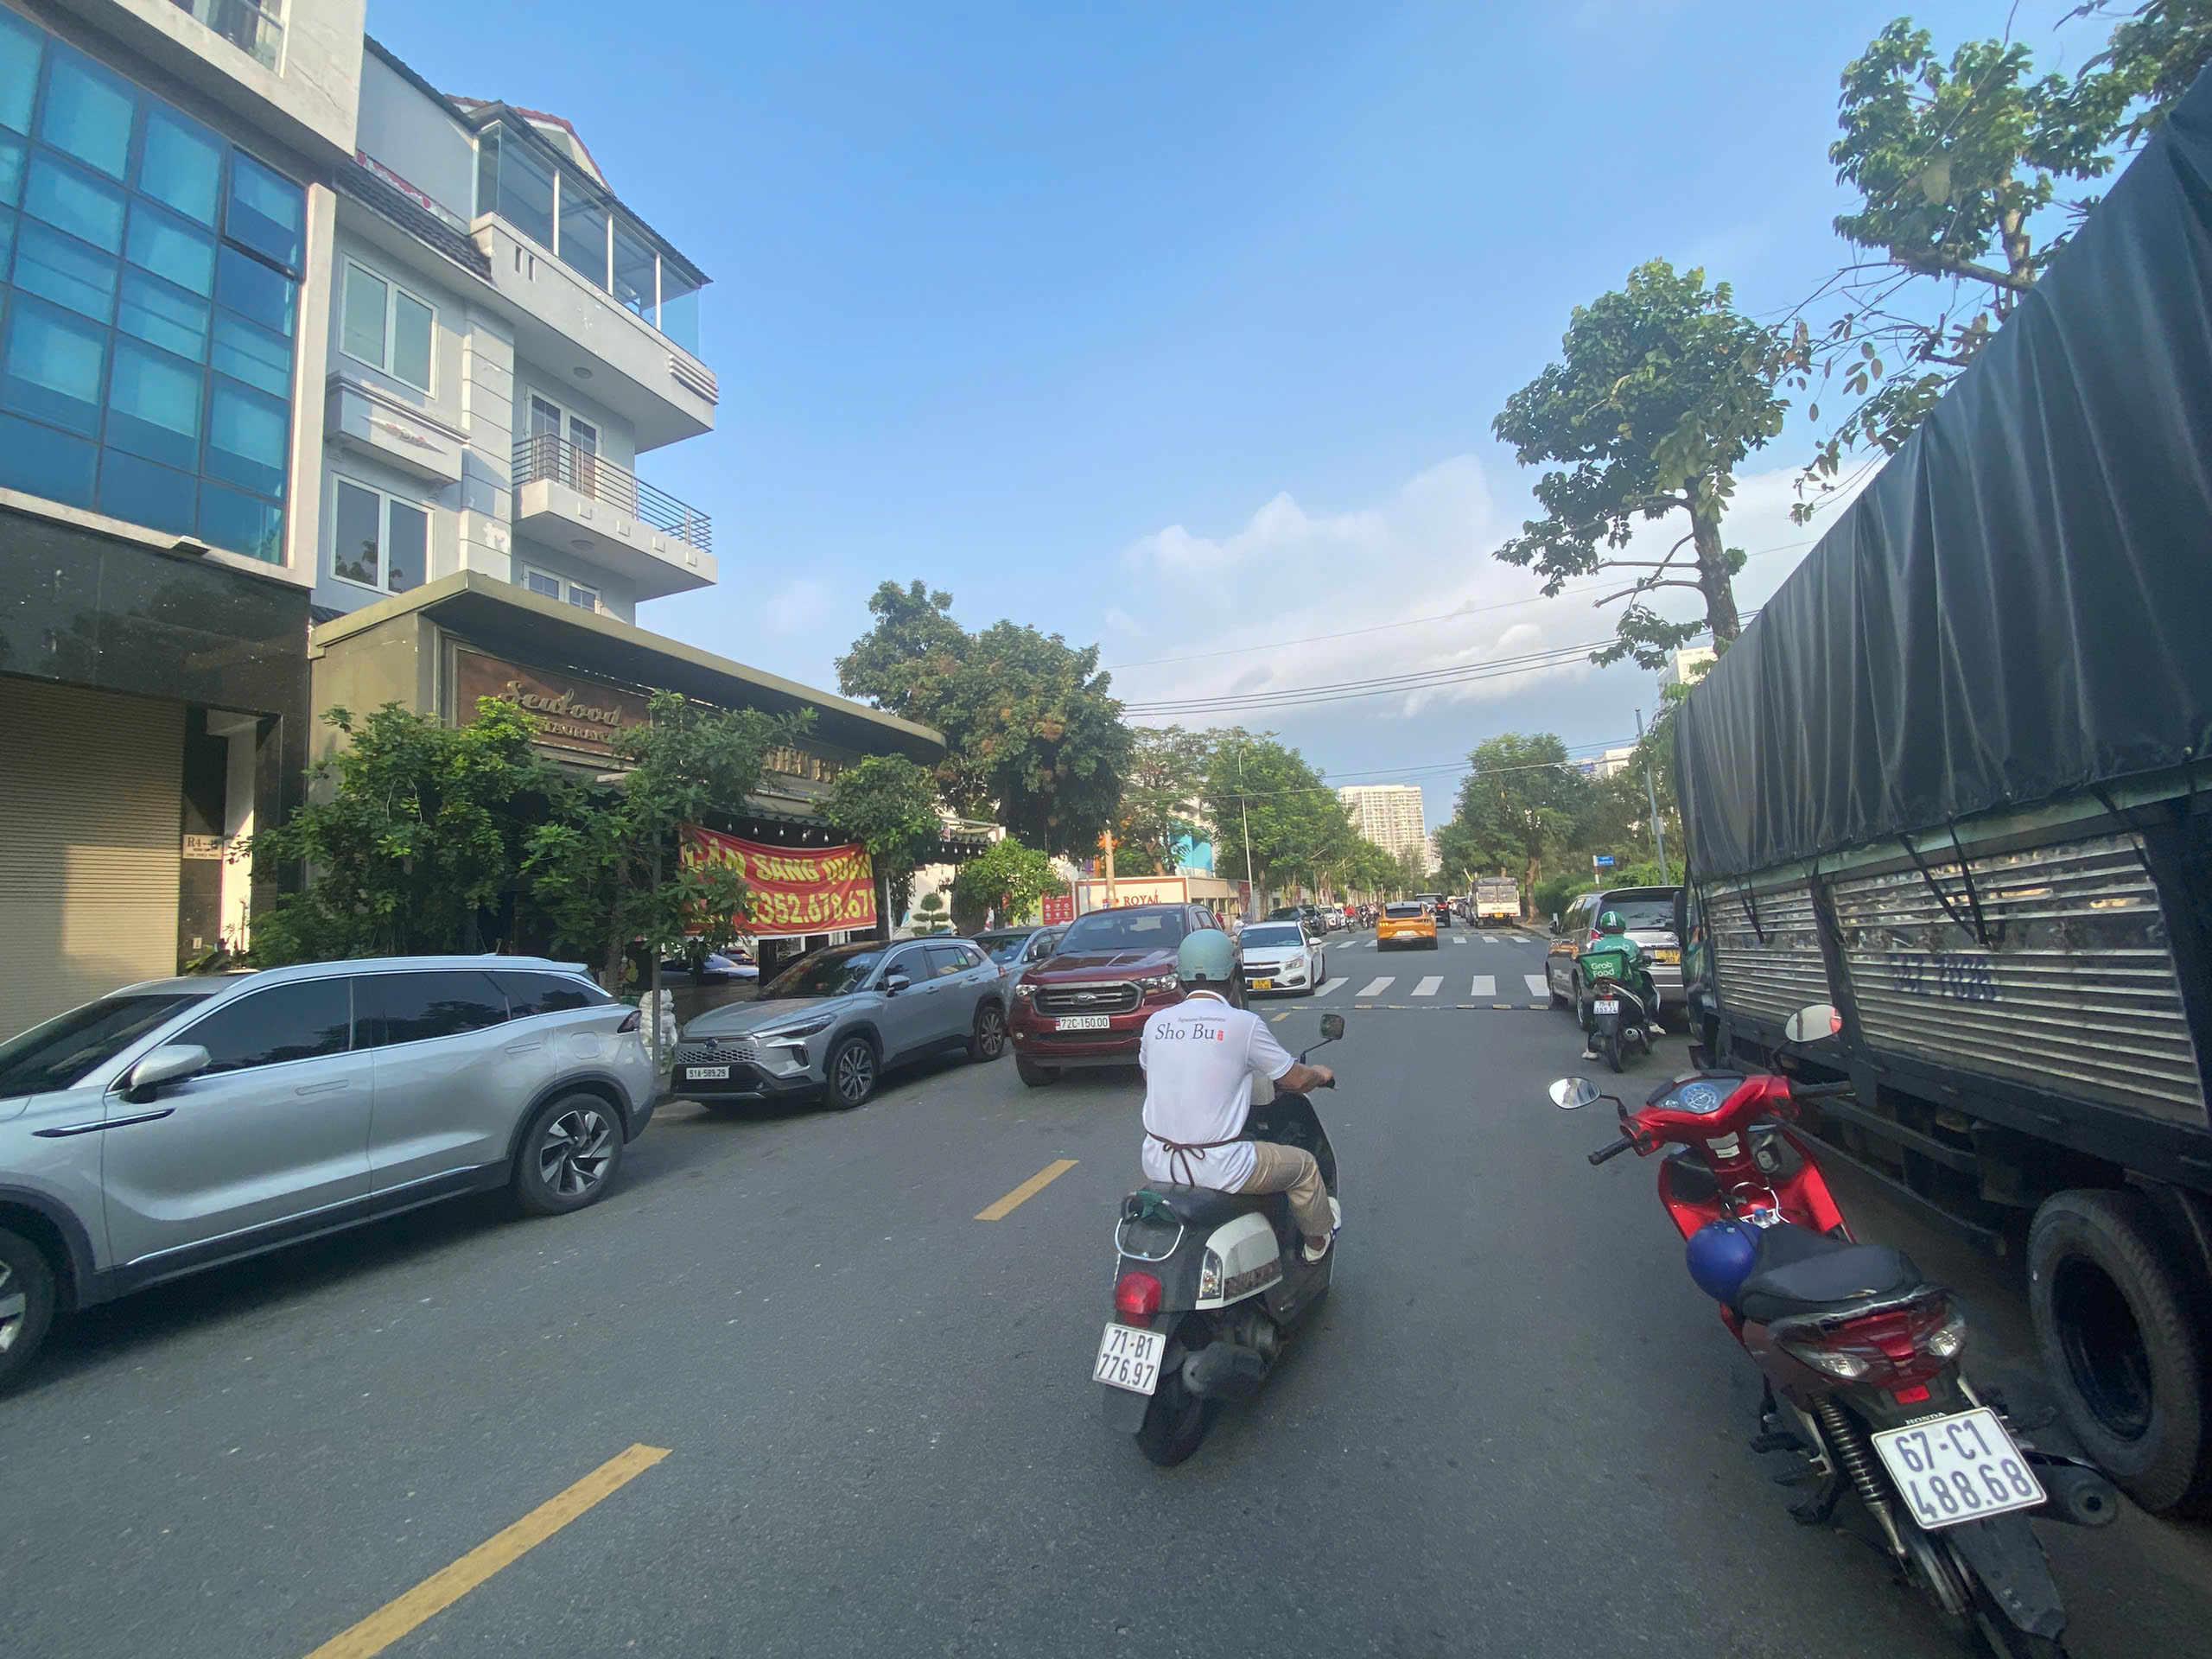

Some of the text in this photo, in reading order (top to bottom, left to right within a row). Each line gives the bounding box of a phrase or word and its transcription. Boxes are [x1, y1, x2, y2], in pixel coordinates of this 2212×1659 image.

[498, 680, 623, 726] Seafood
[543, 719, 611, 743] TAURAN
[752, 854, 820, 881] SANG
[1123, 893, 1161, 906] ROYAL
[1591, 961, 1613, 970] Grab
[1592, 968, 1615, 977] Food
[1061, 1017, 1109, 1028] 72C-150.00
[1155, 1023, 1185, 1039] Sho
[1192, 1023, 1215, 1039] Bu
[1109, 1329, 1154, 1361] 71-B1
[1098, 1353, 1155, 1389] 776.97
[1905, 1412, 1947, 1425] HONDA
[1895, 1419, 1992, 1472] 67-C1
[1910, 1458, 2032, 1519] 488.68
